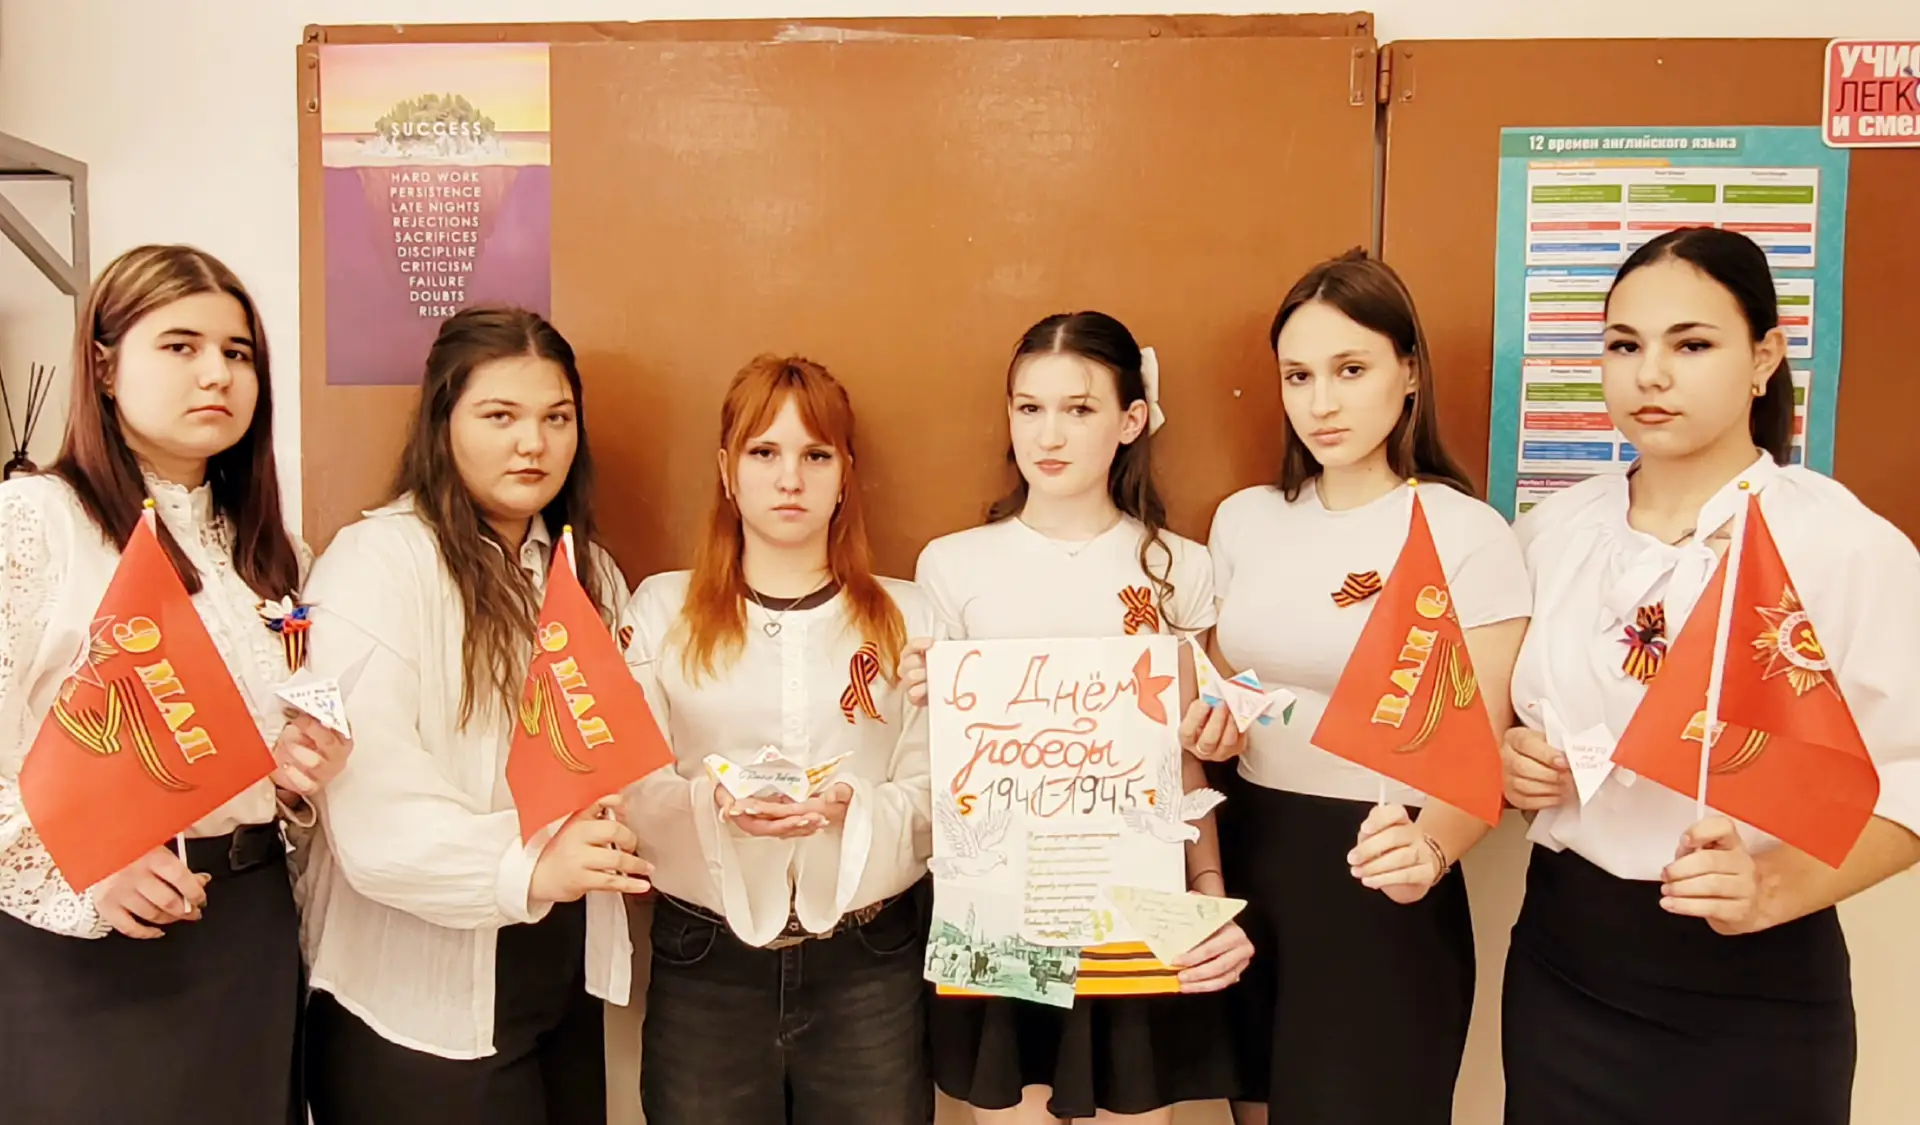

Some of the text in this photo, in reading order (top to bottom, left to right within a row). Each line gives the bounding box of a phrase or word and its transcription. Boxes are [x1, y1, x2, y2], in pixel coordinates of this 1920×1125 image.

[1835, 80, 1920, 112] ЛЕГК
[390, 121, 482, 137] SUCCESS
[1529, 135, 1737, 153] 12 времен английского языка
[391, 172, 479, 183] HARD WORK
[390, 187, 481, 198] PERSISTENCE
[391, 202, 480, 213] LATE NIGHTS
[393, 217, 479, 228] REJECTIONS
[395, 231, 478, 243] SACRIFICES
[397, 246, 477, 258] DISCIPLINE
[400, 261, 473, 273] CRITICISM
[409, 276, 465, 287] FAILURE
[410, 291, 465, 302] DOUBTS
[419, 305, 456, 317] RISKS
[112, 616, 217, 764] 9 МАЯ
[539, 621, 615, 749] 9 МАЯ
[950, 717, 1145, 795] Победы
[980, 774, 1146, 817] 1941-1945
